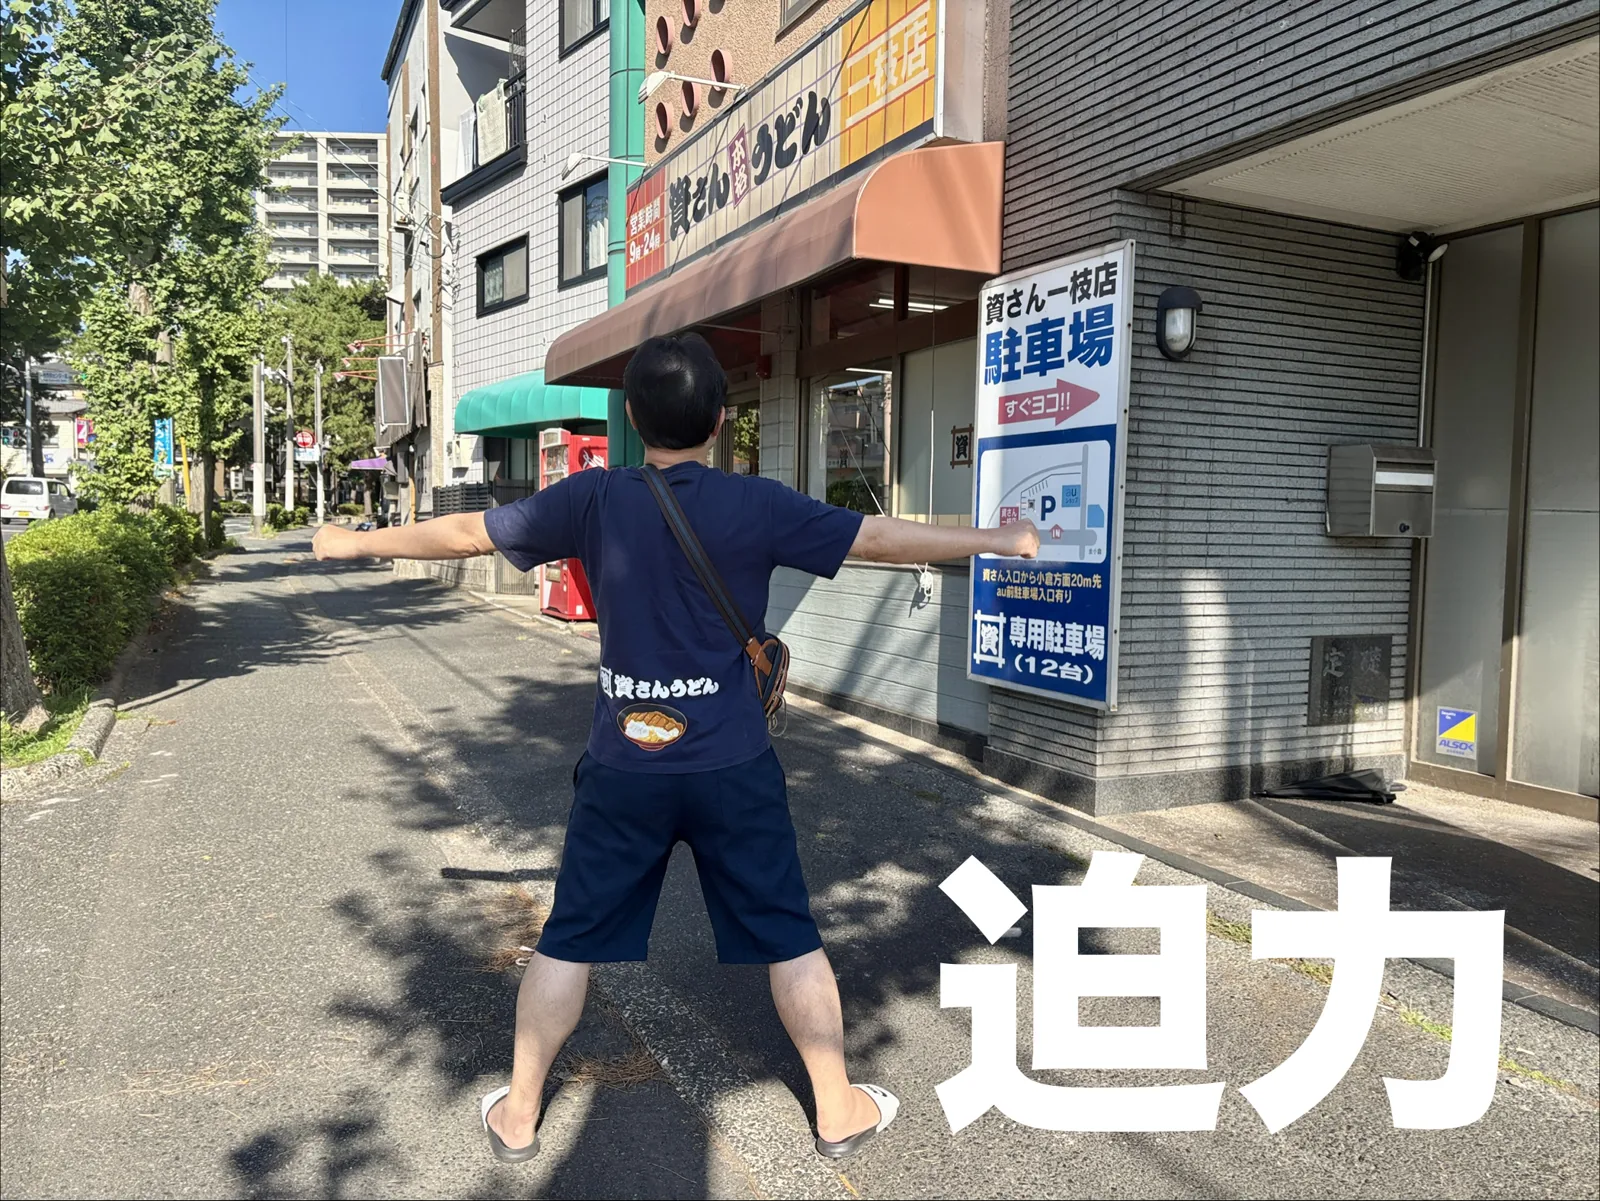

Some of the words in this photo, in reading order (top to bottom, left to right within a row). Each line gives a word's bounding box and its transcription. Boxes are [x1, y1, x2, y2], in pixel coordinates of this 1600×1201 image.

[847, 18, 929, 97] 一枝店
[669, 163, 730, 241] 資さん
[751, 91, 831, 186] うどん
[986, 261, 1118, 325] 資さん一枝店
[984, 303, 1114, 385] 駐車場
[1041, 495, 1056, 521] P
[982, 567, 1102, 589] 資さん入口から小倉方面20m先
[996, 585, 1072, 604] au前駐車場入口有り
[1009, 615, 1105, 661] 専用駐車場
[614, 674, 719, 699] 資さんうどん
[1439, 739, 1475, 752] ALSOK
